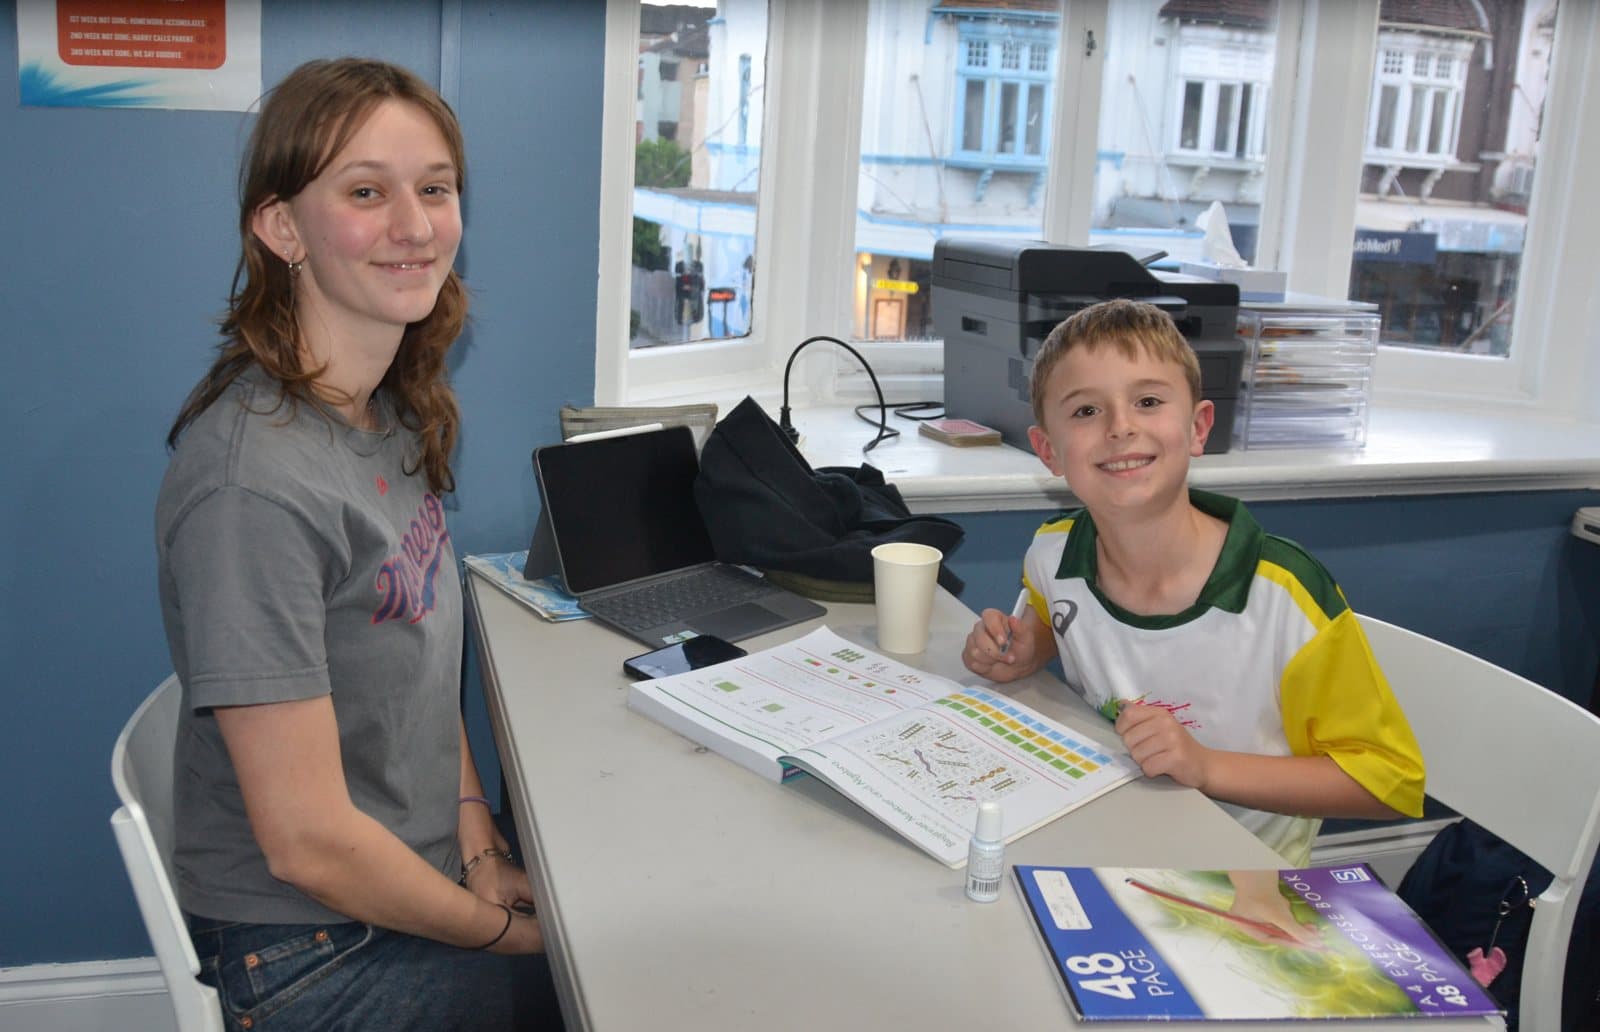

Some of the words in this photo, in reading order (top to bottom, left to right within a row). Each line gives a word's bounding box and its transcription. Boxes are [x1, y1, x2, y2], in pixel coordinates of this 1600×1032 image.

[98, 16, 110, 24] NOT
[101, 33, 113, 41] NOT
[102, 49, 113, 57] NOT
[1284, 874, 1332, 910] BOOK
[1328, 912, 1409, 978] EXERCISE
[1385, 942, 1447, 983] PAGE
[1065, 952, 1137, 1000] 48
[1119, 949, 1175, 997] PAGE
[1436, 984, 1469, 1007] 48
